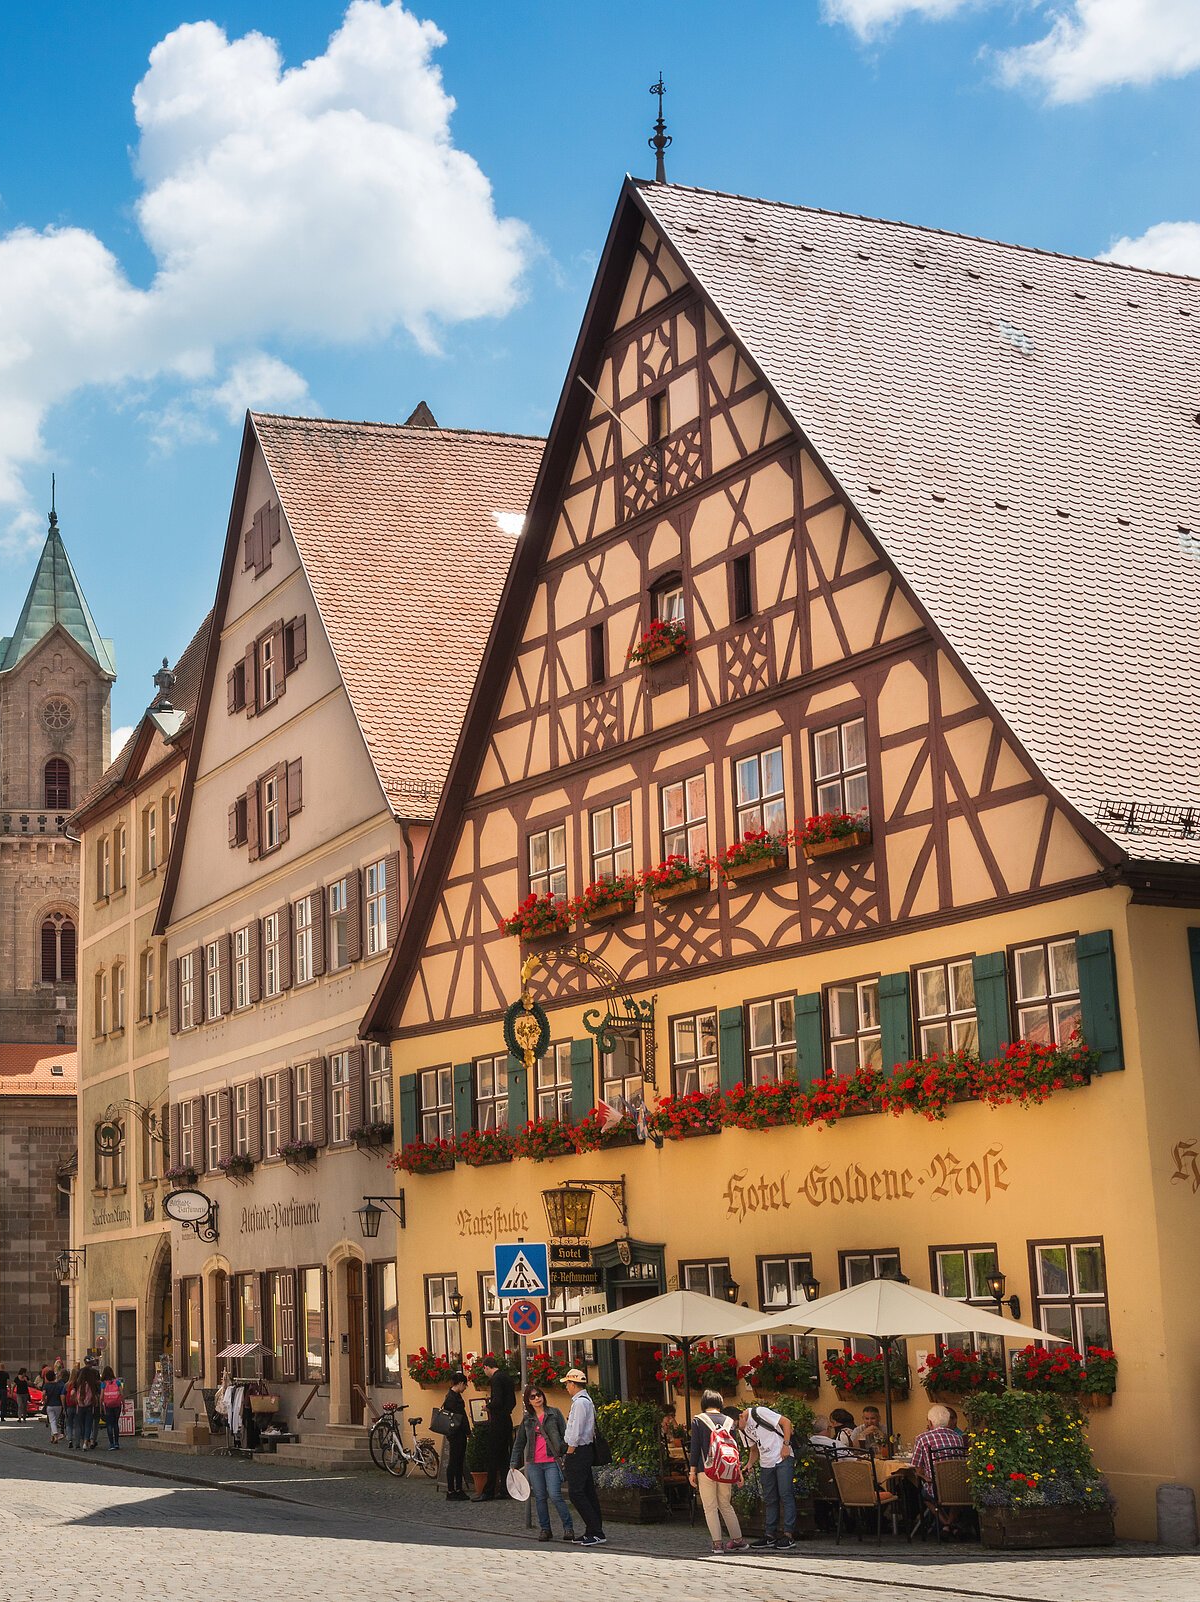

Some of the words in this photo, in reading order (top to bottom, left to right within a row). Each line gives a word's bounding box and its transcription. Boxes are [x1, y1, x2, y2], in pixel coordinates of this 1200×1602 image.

[723, 1168, 791, 1223] Hotel
[798, 1160, 915, 1207] Goldene
[558, 1248, 582, 1258] Hotel
[550, 1270, 598, 1284] fé-Restaurant
[581, 1304, 606, 1316] ZIMMER
